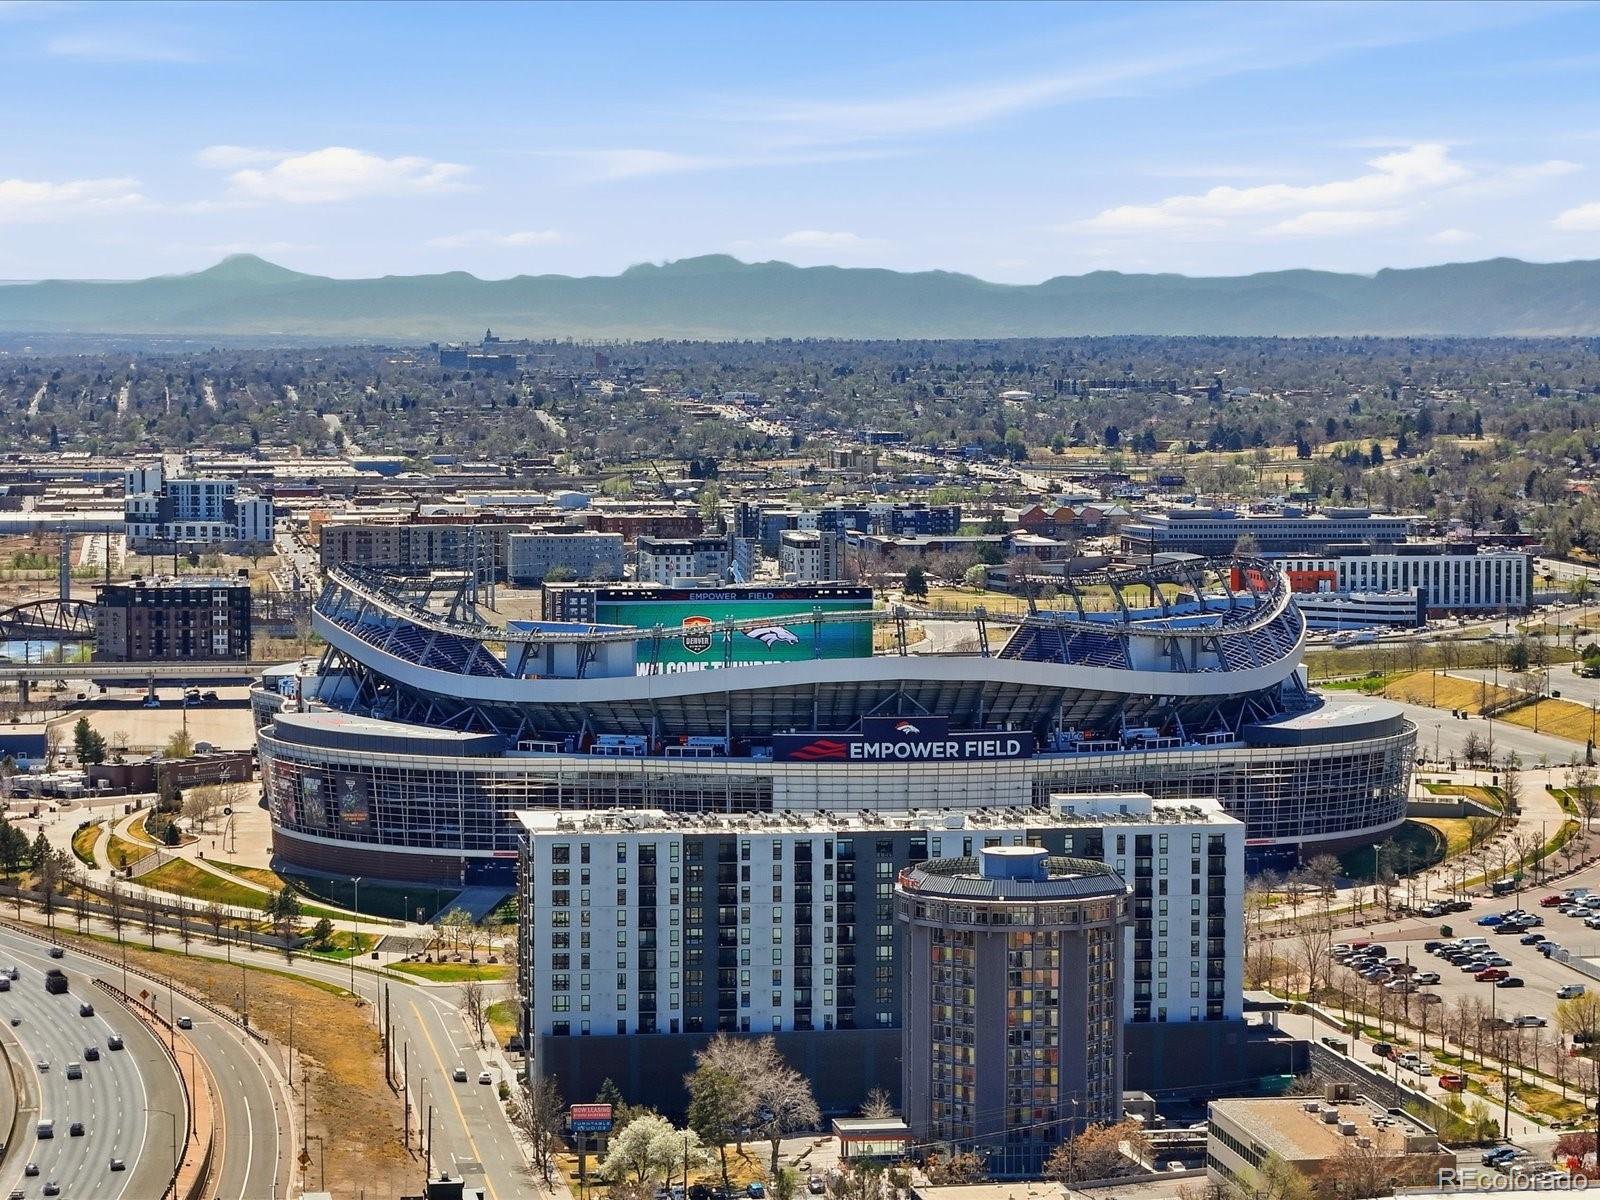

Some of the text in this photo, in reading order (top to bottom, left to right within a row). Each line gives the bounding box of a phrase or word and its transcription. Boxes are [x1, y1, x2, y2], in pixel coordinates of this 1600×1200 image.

[689, 592, 775, 600] EMPOWER FIELD
[685, 637, 709, 645] DENVER
[850, 739, 1021, 759] EMPOWER FIELD
